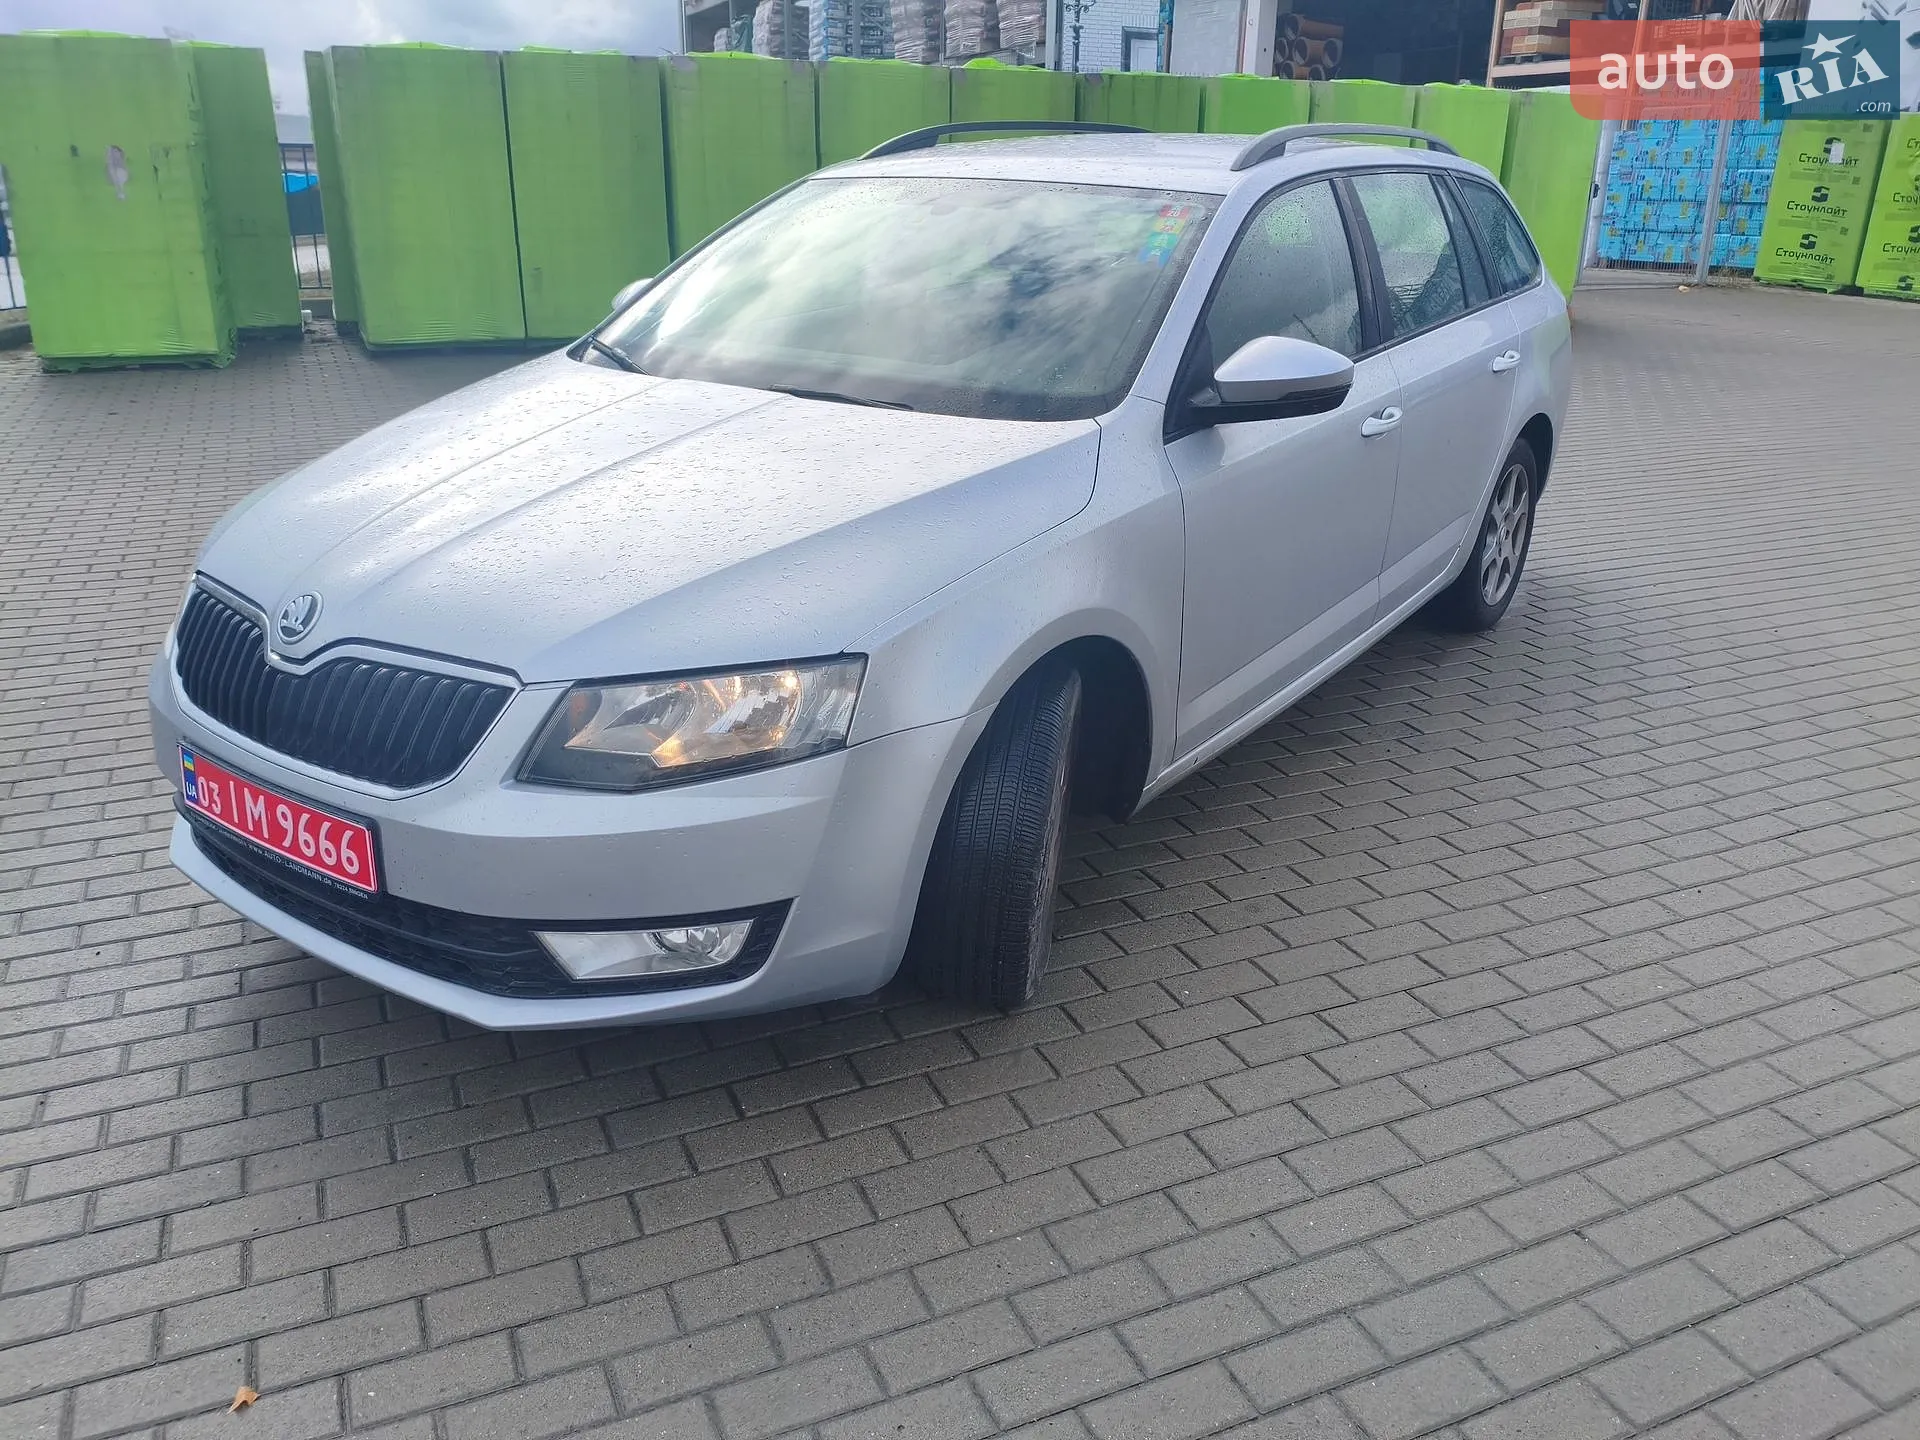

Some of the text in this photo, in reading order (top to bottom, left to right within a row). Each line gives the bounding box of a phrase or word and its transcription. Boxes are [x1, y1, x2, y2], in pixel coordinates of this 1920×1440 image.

[1799, 153, 1859, 168] Стоуайт
[1893, 192, 1920, 206] Стоу
[1787, 201, 1847, 217] Стоунлайт
[1776, 248, 1835, 265] Стоунлайт
[186, 781, 197, 799] UA
[276, 804, 359, 875] 9666
